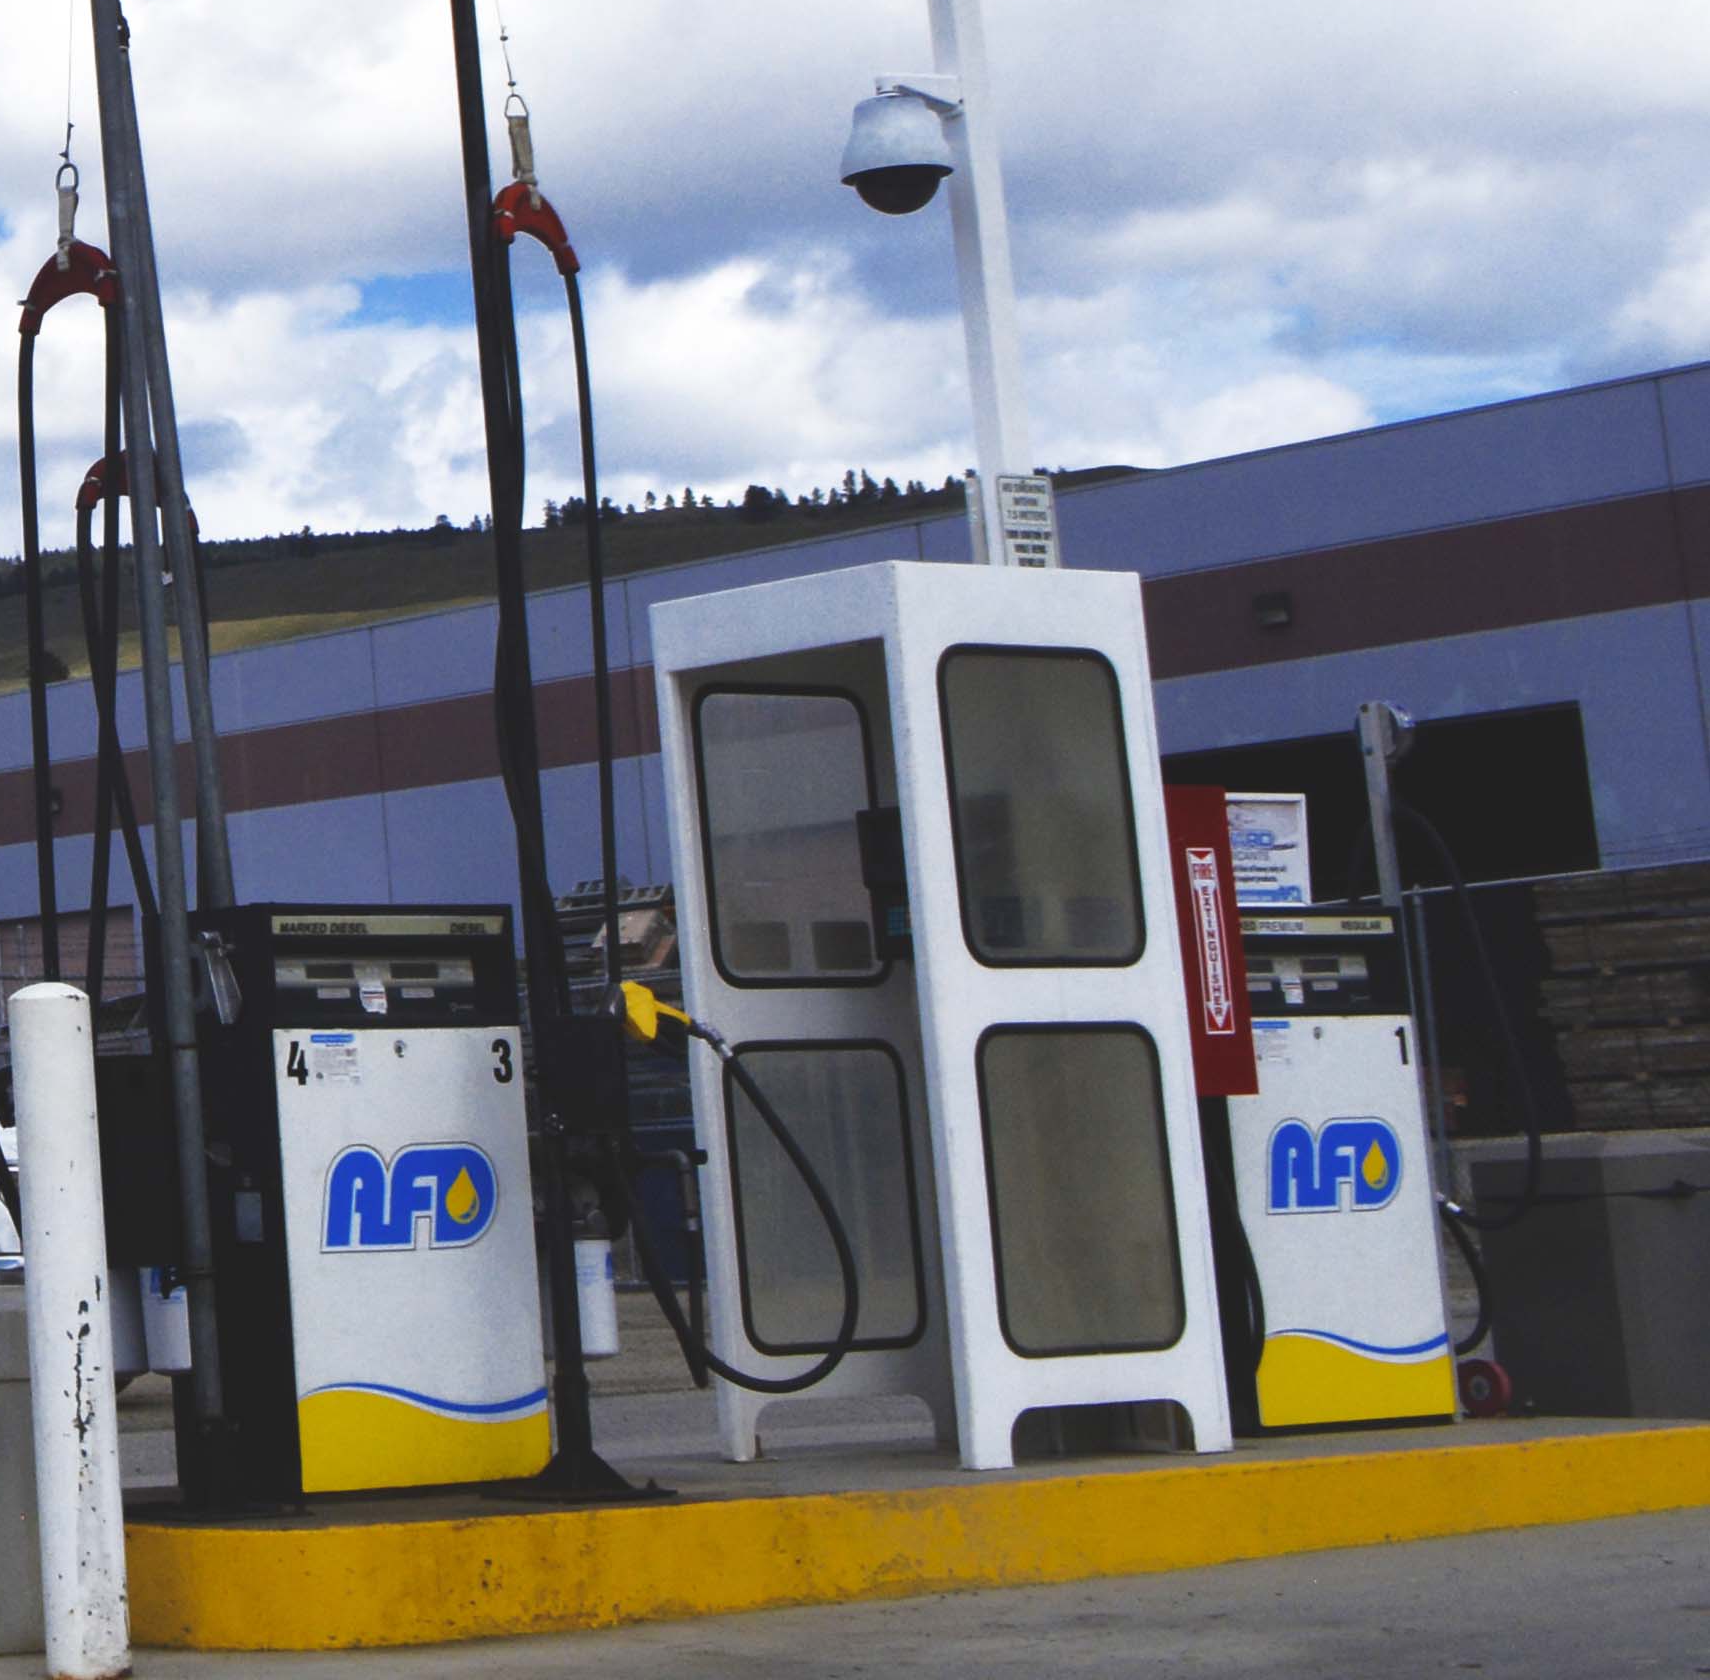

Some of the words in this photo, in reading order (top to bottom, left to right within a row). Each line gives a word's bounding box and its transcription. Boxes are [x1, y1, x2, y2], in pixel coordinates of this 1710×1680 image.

[1194, 863, 1215, 880] FIRE
[280, 922, 327, 934] MARKED
[330, 922, 368, 934] DIESEL
[450, 922, 486, 934] DIESEL
[1201, 886, 1223, 1016] EXTINGUISHER
[287, 1041, 309, 1086] 4
[491, 1039, 513, 1084] 3
[1395, 1026, 1409, 1065] 1
[1268, 1119, 1401, 1211] AFD
[323, 1145, 497, 1250] AFD
